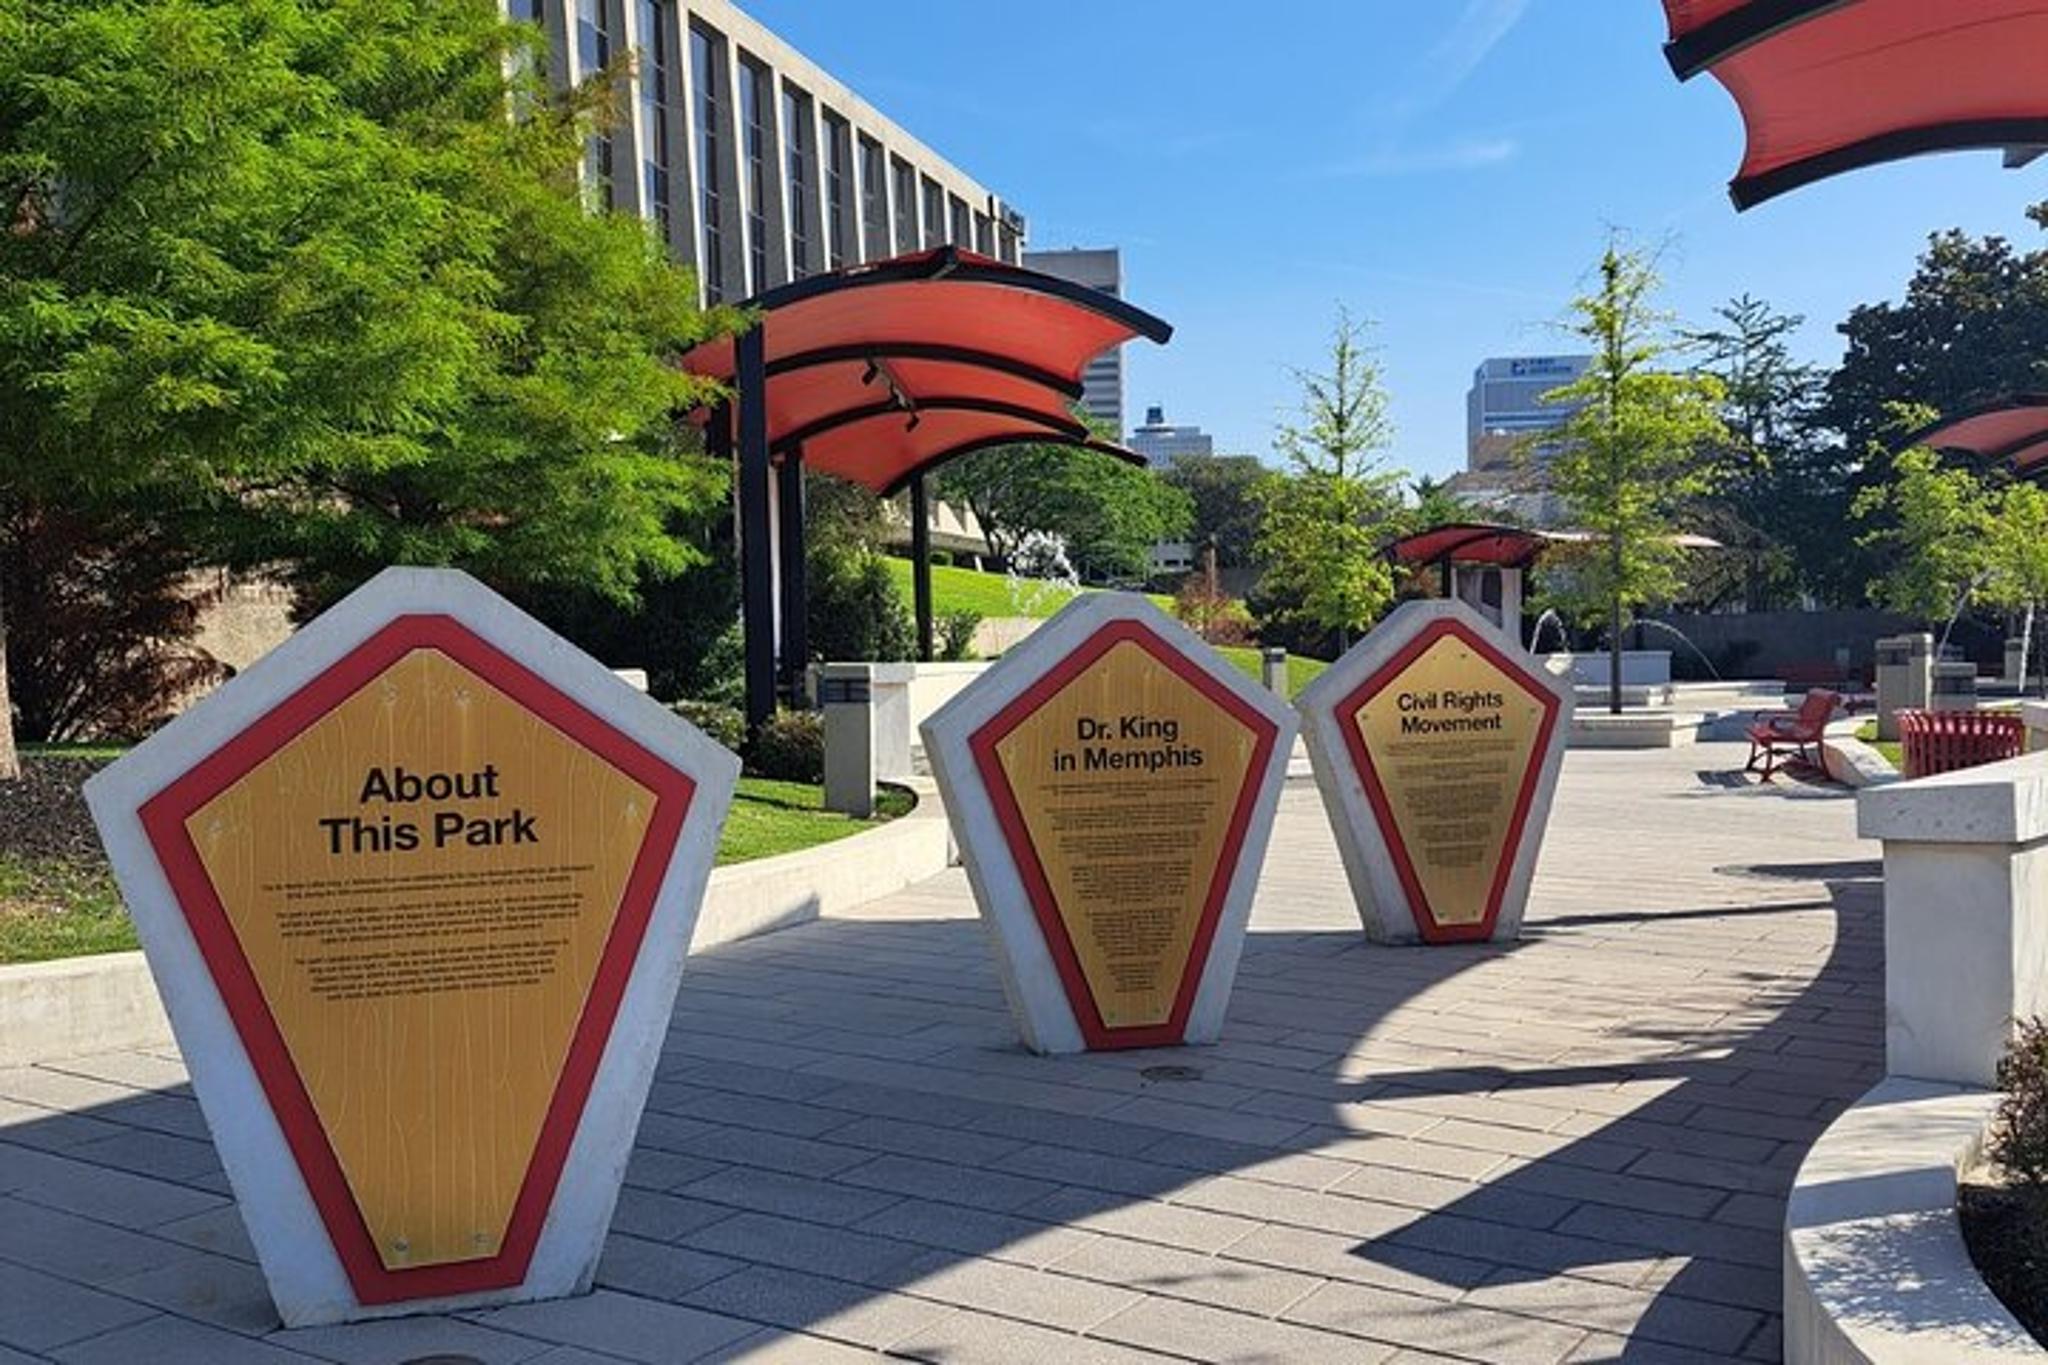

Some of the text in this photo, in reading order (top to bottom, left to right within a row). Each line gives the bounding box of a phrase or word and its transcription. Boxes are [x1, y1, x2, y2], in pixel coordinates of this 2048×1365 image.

[1398, 690, 1504, 713] Civil Rights
[1077, 716, 1179, 742] Dr. King
[1402, 713, 1502, 734] Movement
[1054, 745, 1204, 773] in Memphis
[360, 764, 499, 804] About
[318, 809, 539, 853] This Park
